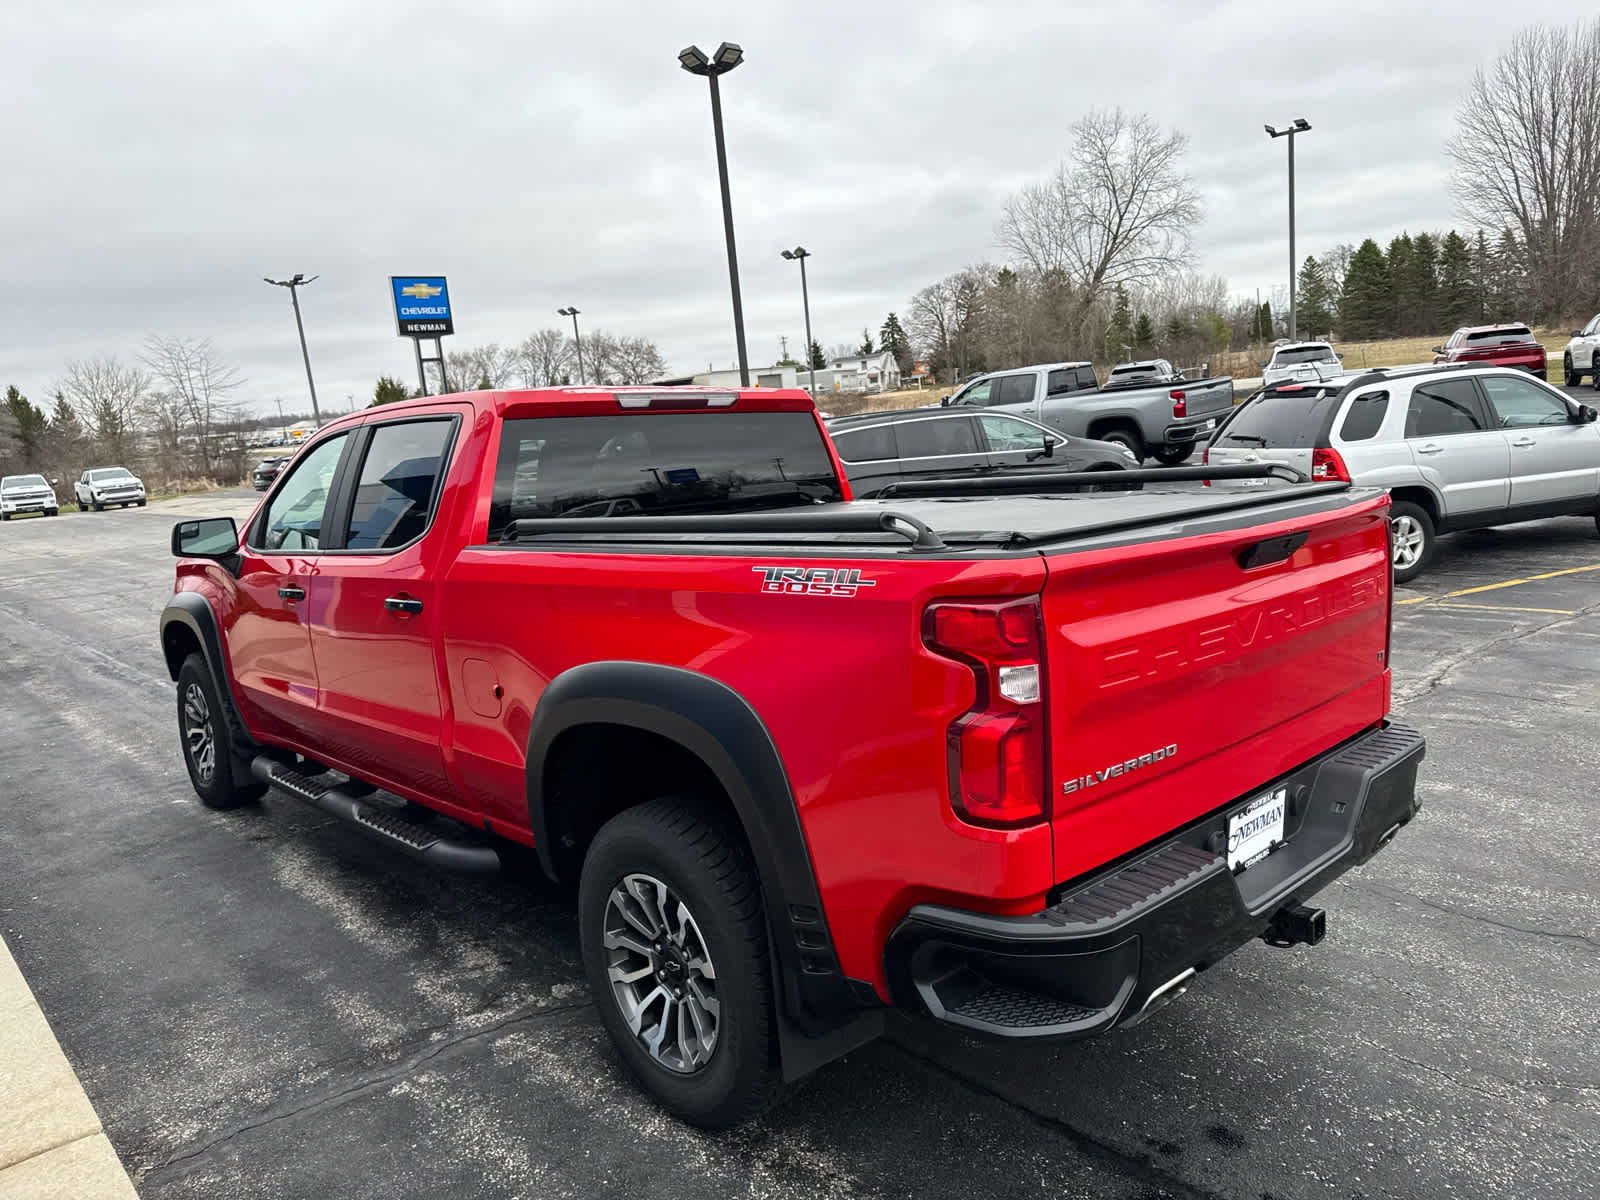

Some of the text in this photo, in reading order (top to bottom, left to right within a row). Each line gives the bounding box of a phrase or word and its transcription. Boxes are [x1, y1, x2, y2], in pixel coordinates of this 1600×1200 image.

[401, 306, 447, 315] CHEVROLET
[407, 323, 447, 332] NEWMAN
[752, 566, 876, 587] TRAIL
[761, 581, 857, 598] BOSS
[1063, 743, 1178, 795] SILVERADO
[1234, 804, 1284, 840] NEWMAN
